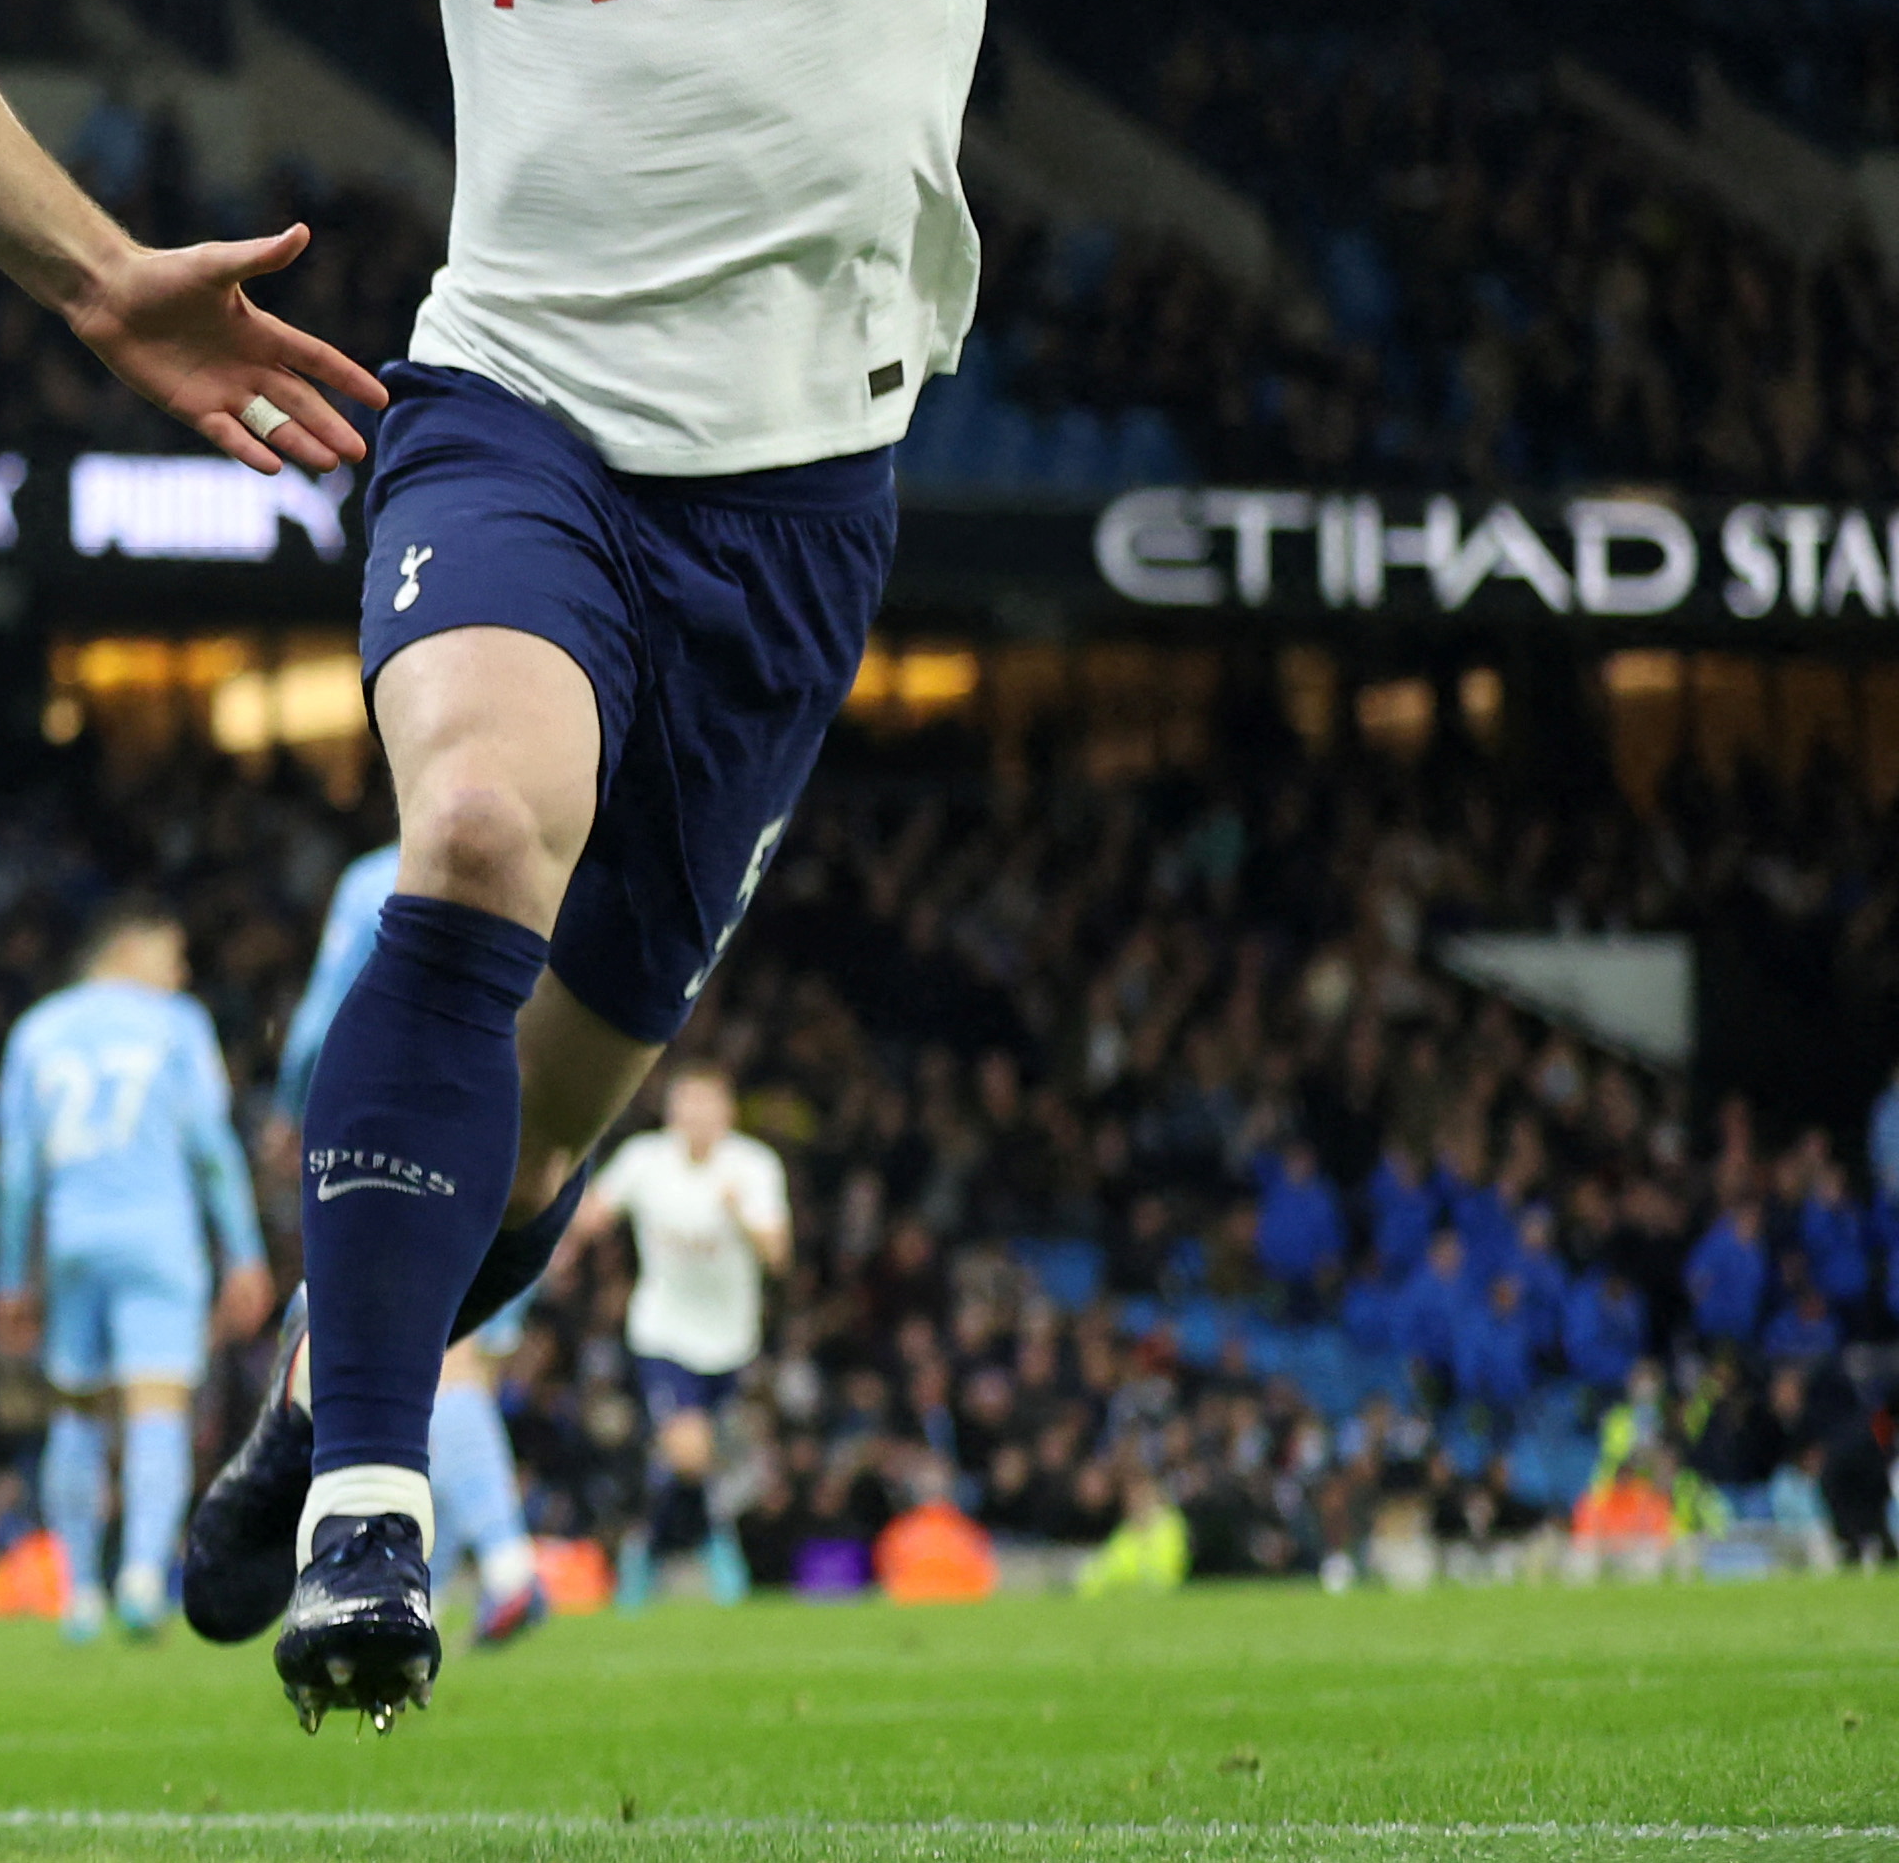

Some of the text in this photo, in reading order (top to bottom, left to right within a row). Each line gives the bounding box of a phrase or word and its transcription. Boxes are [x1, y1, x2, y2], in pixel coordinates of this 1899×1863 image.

[1092, 485, 1899, 619] ETIHAD STA
[32, 1042, 167, 1168] 27
[308, 1148, 456, 1197] SPURS
